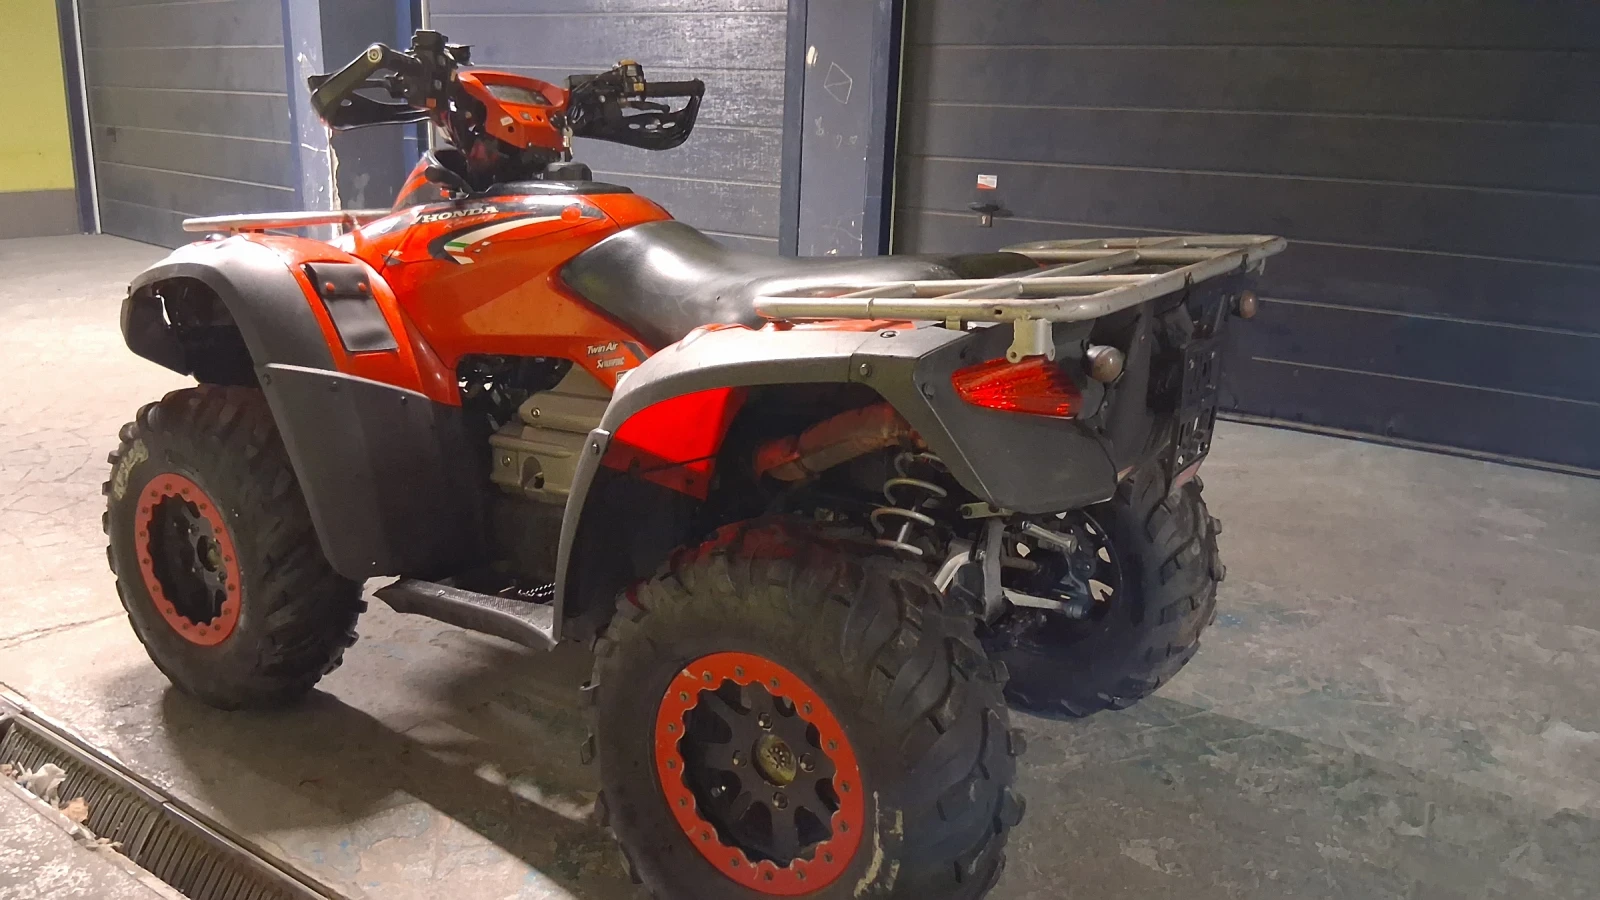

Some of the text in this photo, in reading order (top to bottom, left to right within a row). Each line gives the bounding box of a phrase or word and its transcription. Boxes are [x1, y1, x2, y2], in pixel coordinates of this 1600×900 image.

[421, 205, 499, 223] HONDA
[587, 342, 619, 355] Twin Air
